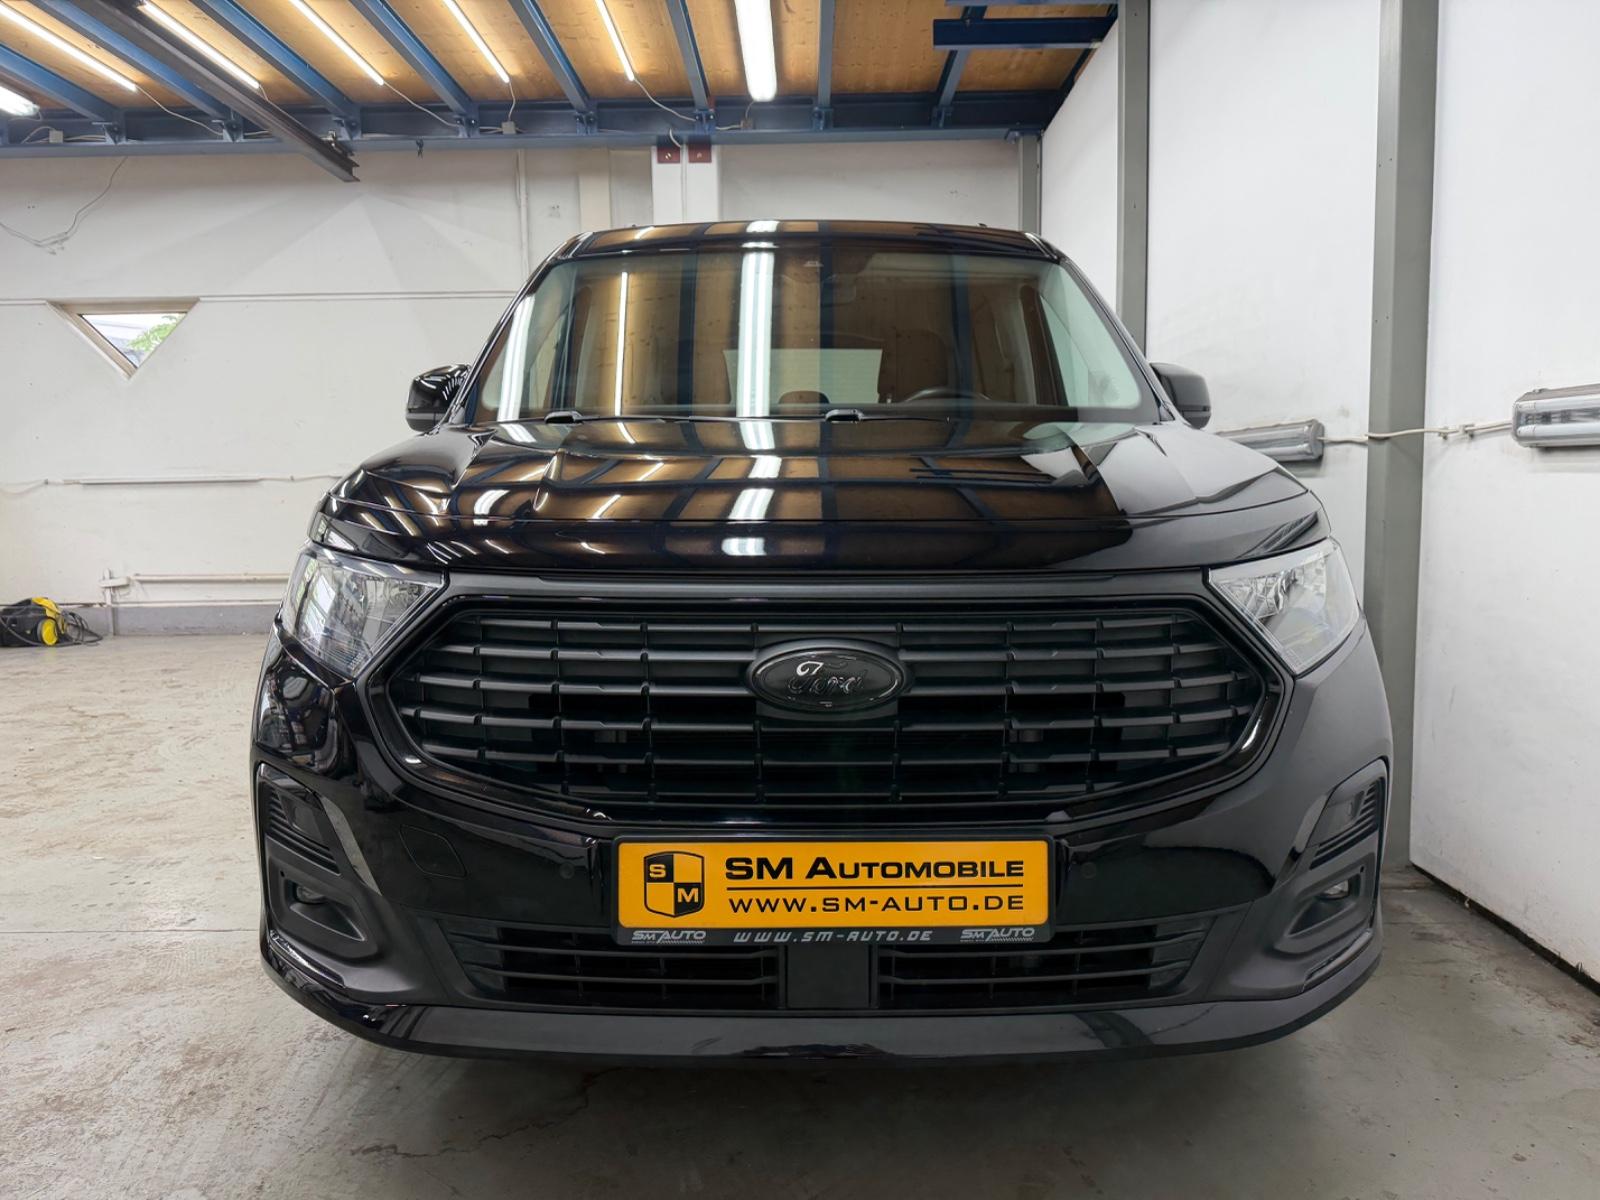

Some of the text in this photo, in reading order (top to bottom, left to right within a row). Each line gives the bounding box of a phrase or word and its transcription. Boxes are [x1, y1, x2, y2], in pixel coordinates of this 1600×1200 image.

[788, 660, 868, 695] Ford
[649, 864, 666, 878] S
[725, 856, 1024, 880] SM AUTOMOBILE
[677, 887, 699, 903] M
[729, 895, 1024, 913] WWW.SM-AUTO.DE
[733, 930, 933, 943] WWW.SM-AUTO.DE
